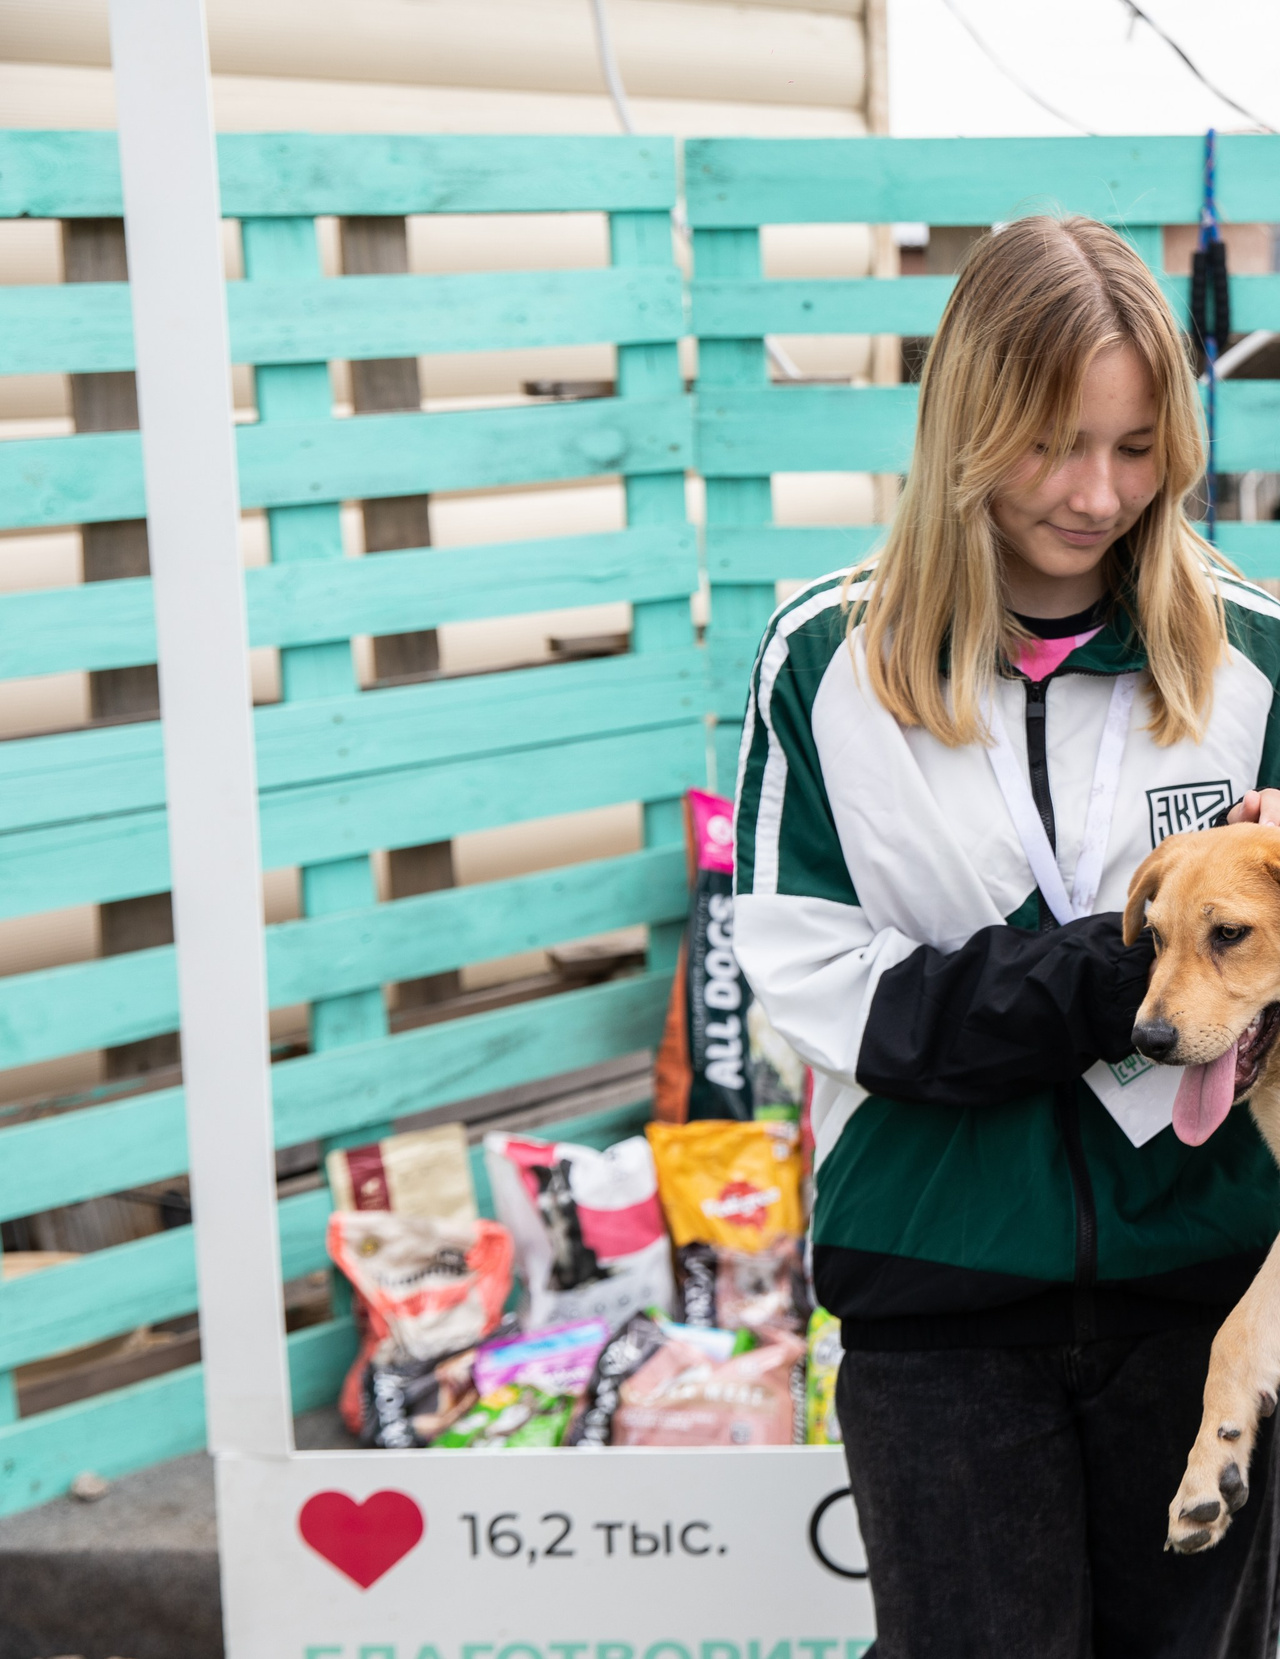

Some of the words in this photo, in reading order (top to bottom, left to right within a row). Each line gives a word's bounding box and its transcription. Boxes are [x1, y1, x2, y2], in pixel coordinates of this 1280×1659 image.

[705, 893, 742, 1011] DOGS
[704, 1014, 745, 1090] ALL
[460, 1512, 576, 1566] 16,2
[593, 1518, 729, 1558] тыс.
